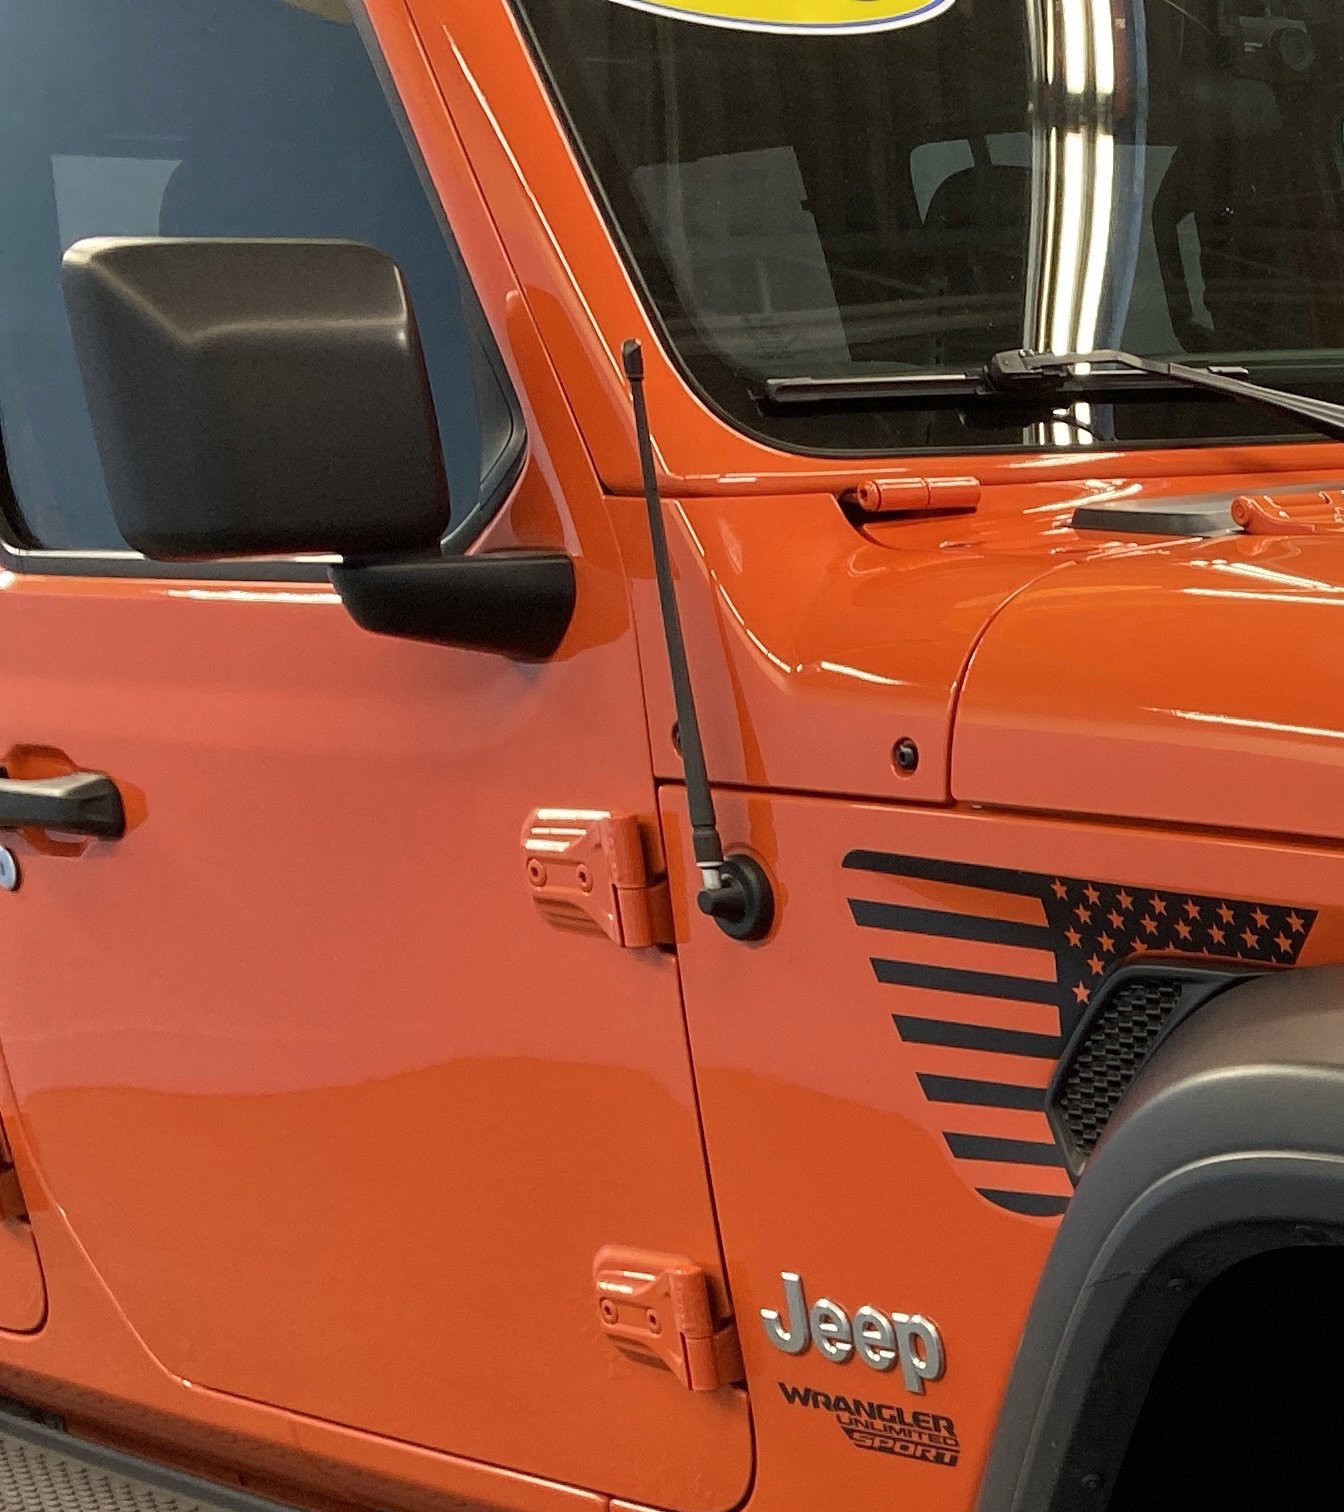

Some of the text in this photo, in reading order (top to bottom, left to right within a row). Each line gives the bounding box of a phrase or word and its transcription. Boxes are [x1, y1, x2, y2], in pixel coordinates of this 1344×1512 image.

[760, 1271, 946, 1394] Jeep
[778, 1382, 956, 1435] WRANGLER
[836, 1414, 960, 1448] UNLIMITED
[850, 1431, 958, 1465] SPORT
